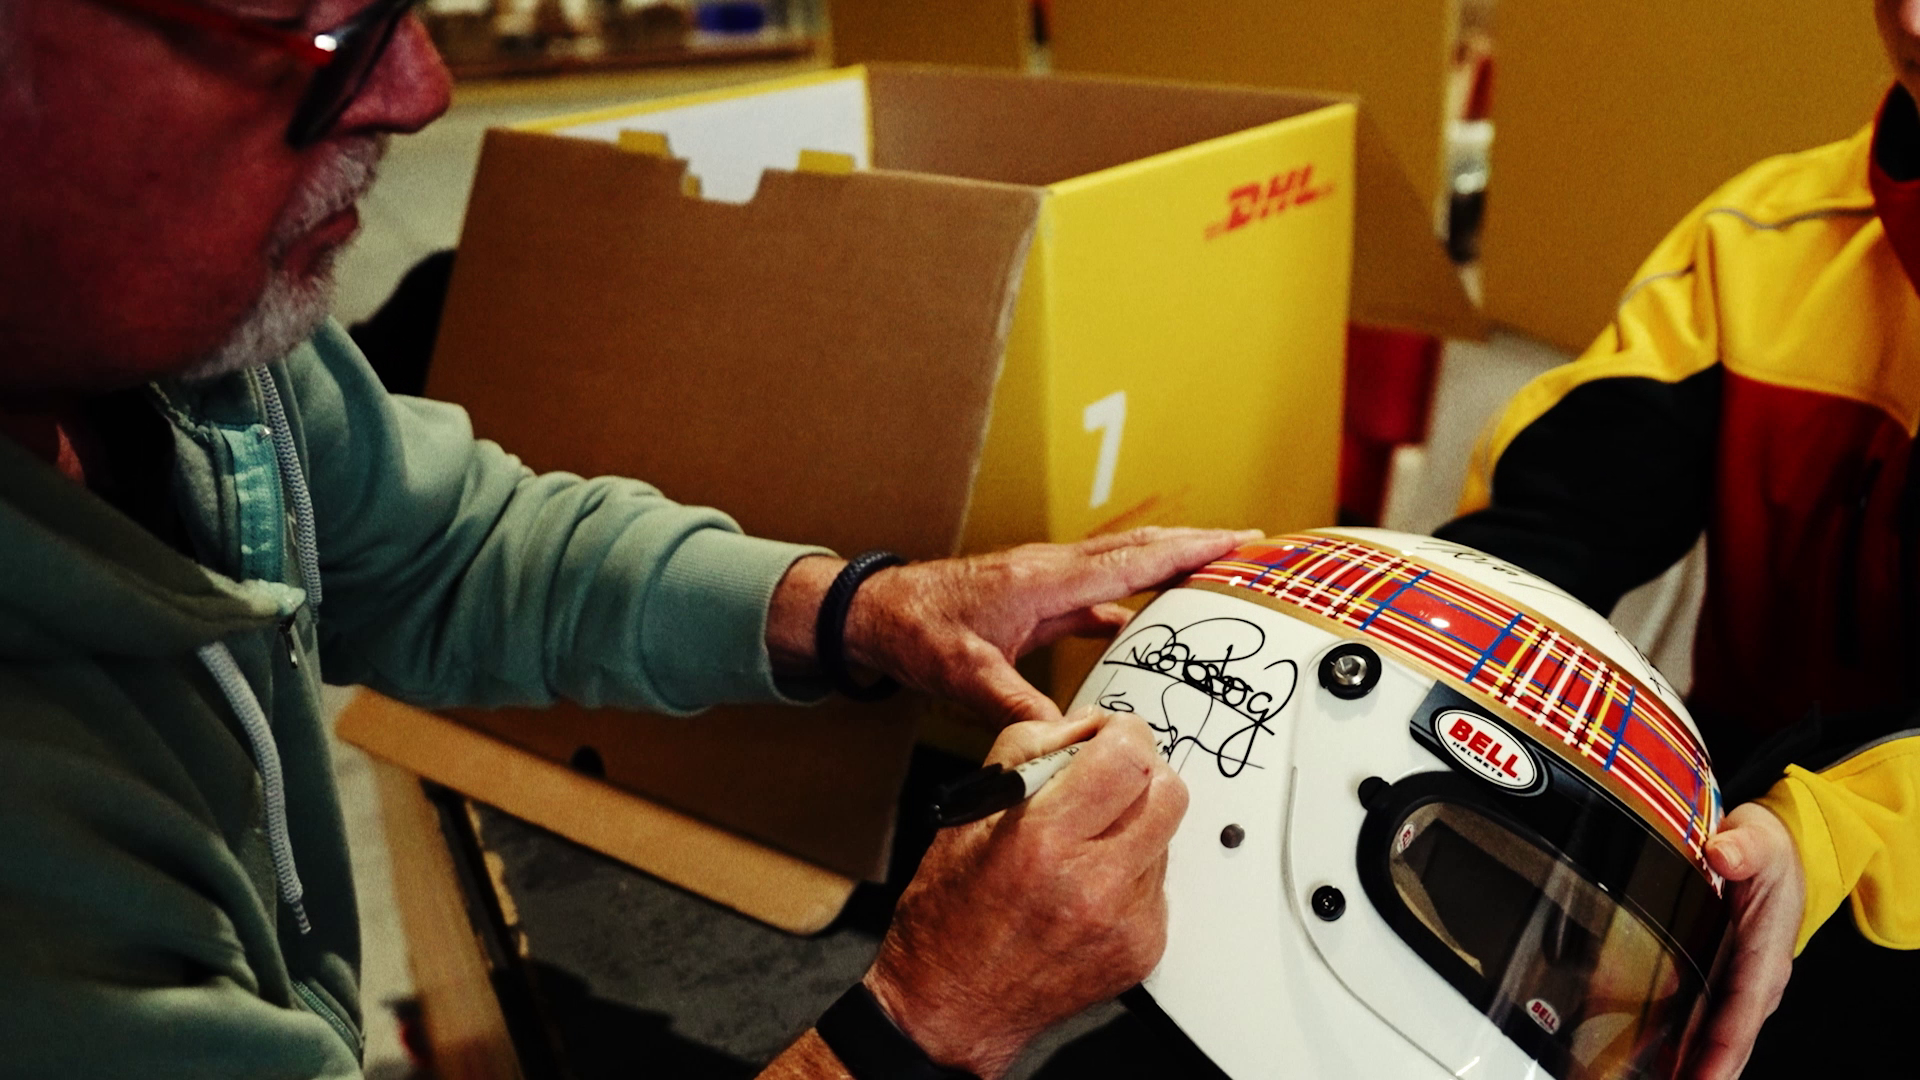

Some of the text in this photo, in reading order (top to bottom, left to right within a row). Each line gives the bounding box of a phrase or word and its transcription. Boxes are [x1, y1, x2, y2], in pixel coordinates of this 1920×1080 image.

[1217, 163, 1329, 233] DHL
[1449, 718, 1518, 779] BELL
[1452, 741, 1503, 778] HELMETS
[1531, 1001, 1556, 1030] BELL
